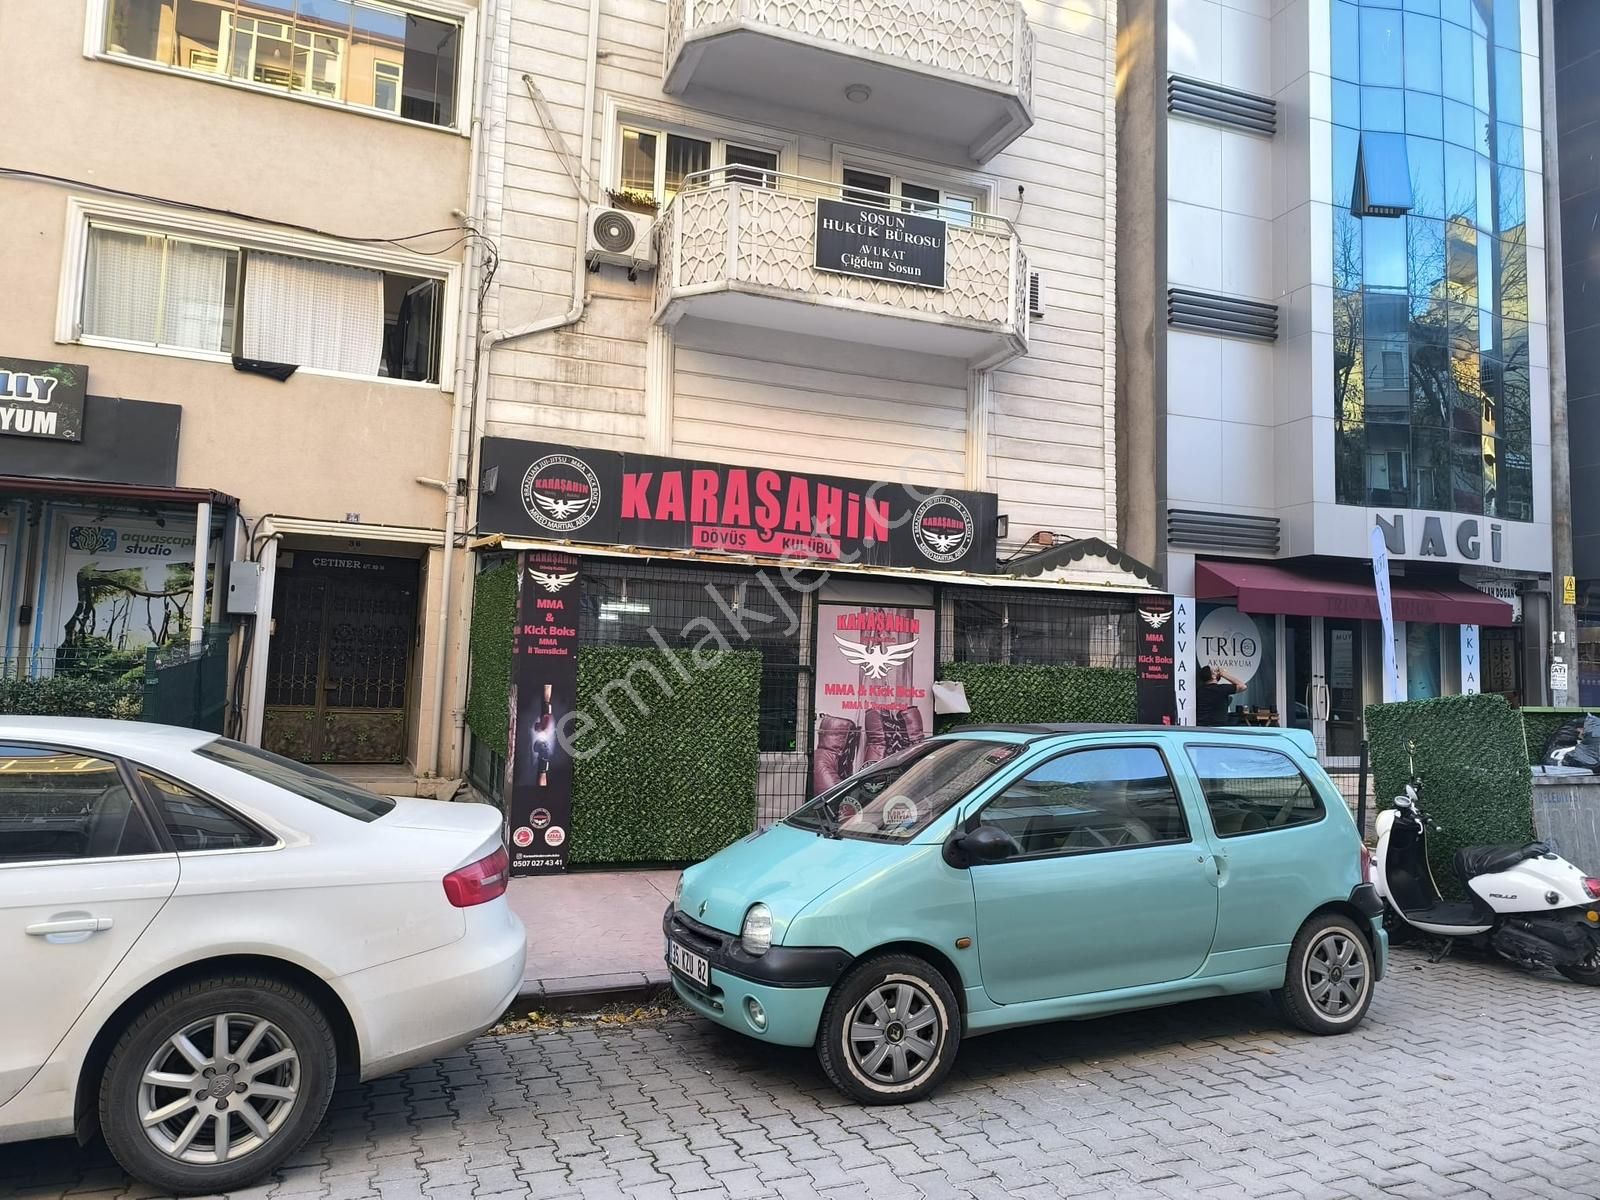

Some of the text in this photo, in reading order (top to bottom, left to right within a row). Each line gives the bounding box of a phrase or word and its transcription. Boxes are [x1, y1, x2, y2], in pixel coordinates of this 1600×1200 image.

[860, 211, 905, 229] SOSUN
[823, 218, 941, 248] HUKUK BÜROSU
[860, 244, 906, 260] AVUKAT
[841, 253, 922, 276] Çiğdem Sosun
[529, 508, 590, 529] MIXED MARTIAL ARTS
[701, 530, 833, 555] DÖVÜŞ KULÜBÜ
[124, 544, 172, 557] studio
[537, 599, 564, 609] MMA
[546, 613, 554, 622] &
[524, 625, 576, 637] Kick Boks
[1145, 633, 1164, 642] MMA
[539, 638, 558, 646] MMA
[1202, 636, 1256, 658] TRIO
[1138, 655, 1173, 665] Kick Boks
[1207, 659, 1252, 668] AKVARYUM
[824, 684, 926, 698] MMA & Kick Boks
[842, 701, 863, 710] MMA
[513, 860, 530, 868] 0507
[697, 959, 707, 983] 82
